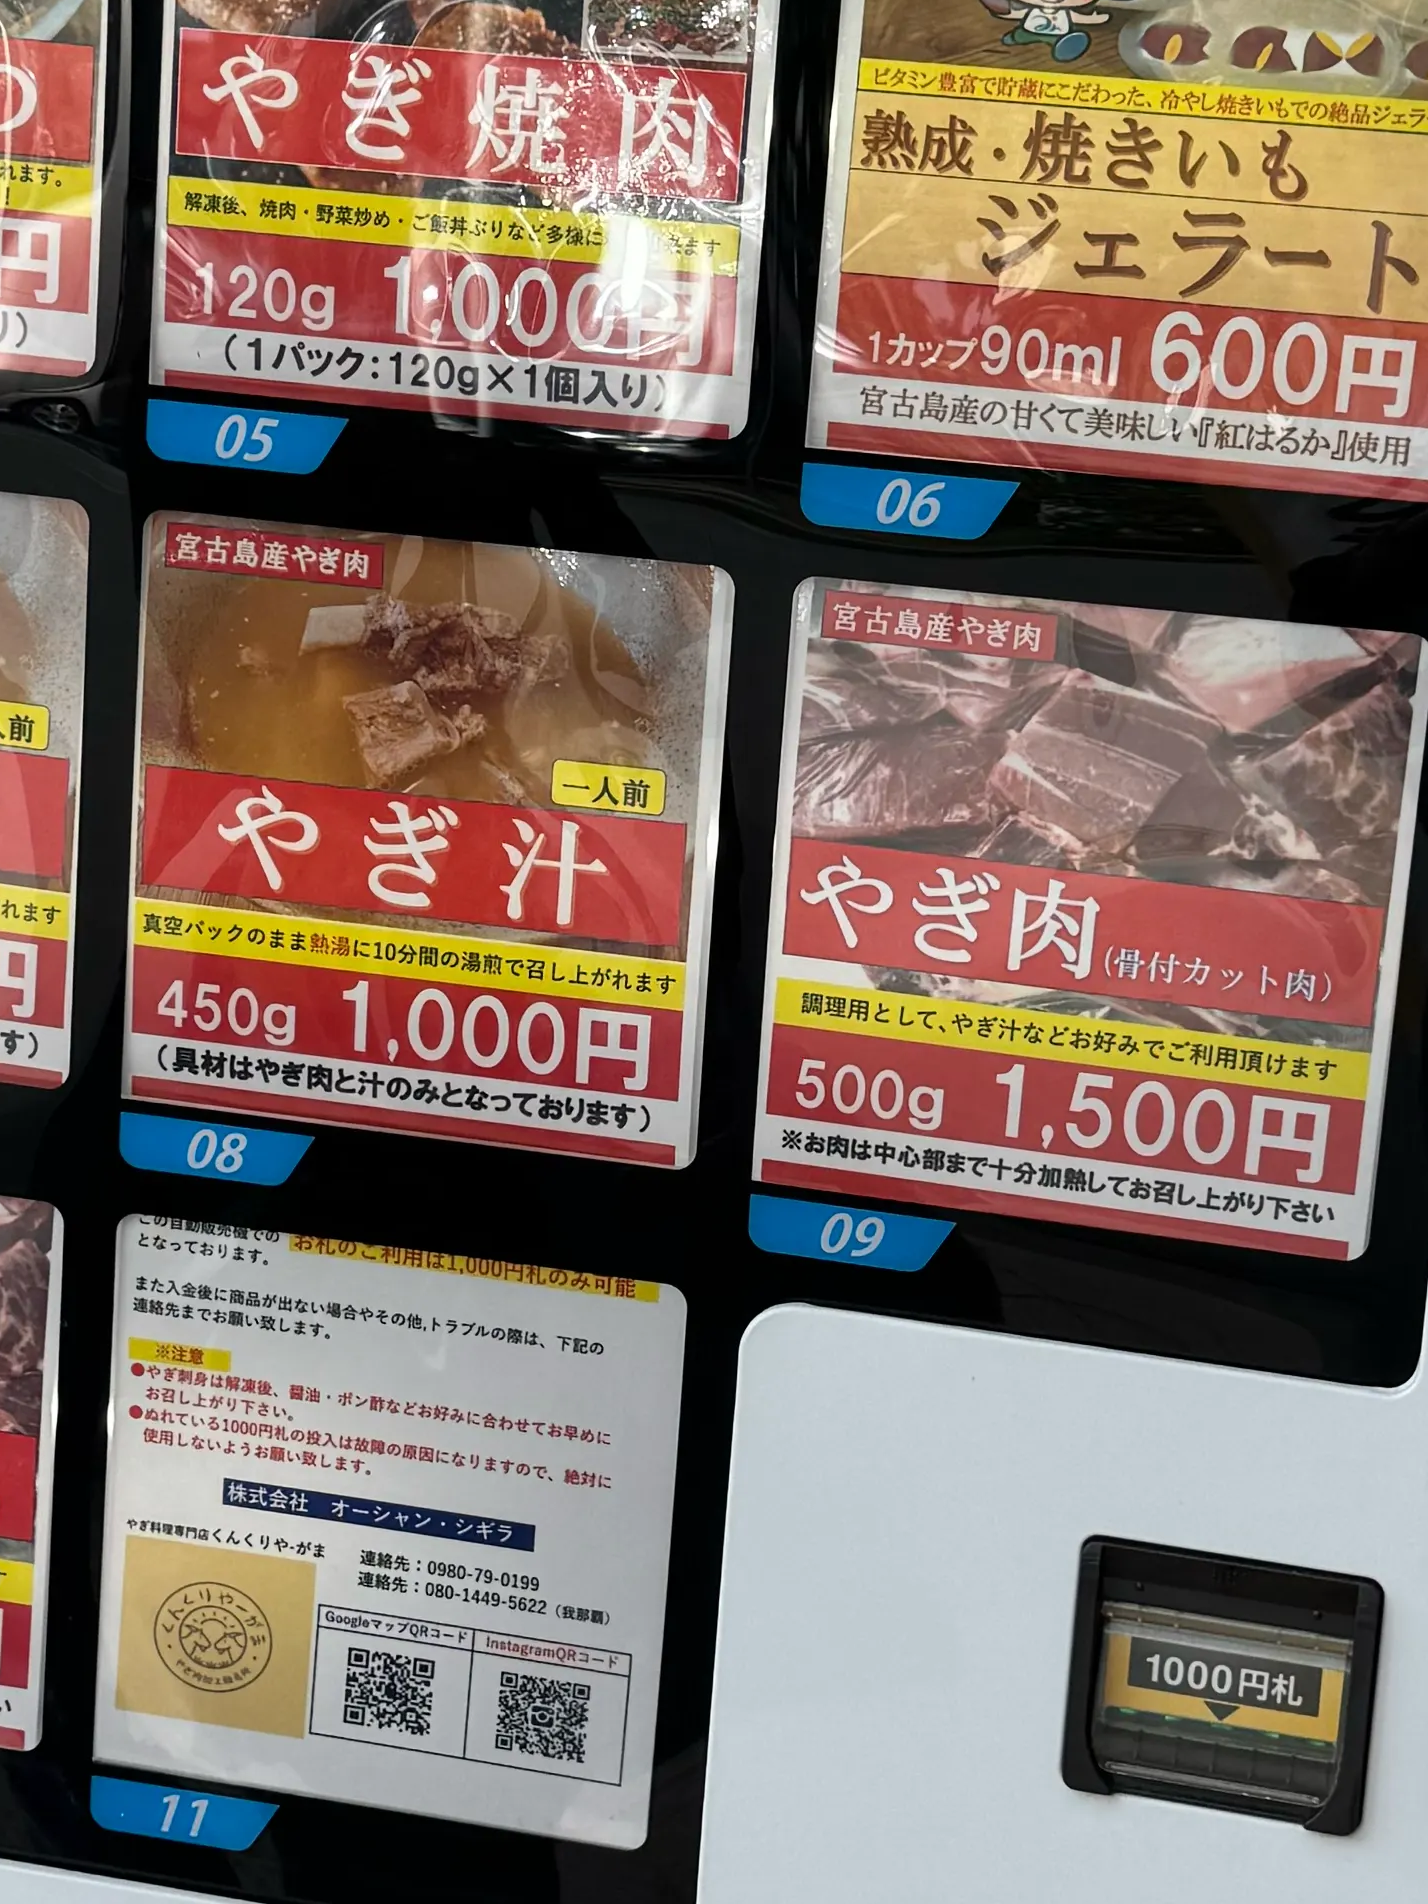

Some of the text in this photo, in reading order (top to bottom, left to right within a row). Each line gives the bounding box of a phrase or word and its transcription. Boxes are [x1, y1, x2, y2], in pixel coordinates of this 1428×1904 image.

[203, 44, 714, 189] やぎ焼肉
[860, 107, 1310, 202] 熟成・焼きいも
[976, 192, 1420, 315] ジェラート
[194, 254, 713, 368] 120g 1,000円
[869, 310, 1418, 420] 1カップ90ml 600円
[215, 413, 280, 463] 05
[860, 385, 1412, 468] 宮古島産の甘くて美味しい『紅はるか』使用
[876, 477, 945, 528] 06
[174, 530, 370, 580] 宮古島産やぎ肉
[831, 600, 1043, 653] 宮古島産やぎ肉
[561, 777, 651, 810] 一人前
[217, 784, 608, 927] やぎ汁
[157, 979, 653, 1094] 450g 1,000円
[800, 991, 1339, 1082] 調理用として、やぎ汁などお好みでご利用頂けます
[156, 1042, 652, 1134] （具材はやぎ肉と汁のみとなっております）
[794, 1058, 1333, 1186] 500g 1,500円
[185, 1127, 248, 1174] 08
[780, 1129, 1336, 1226] ※お肉は中心部まで十分加熱してお召し上がり下さい
[137, 1232, 271, 1267] となっております。
[819, 1211, 886, 1258] 09
[132, 1297, 333, 1341] 連絡先までお願い致します。
[155, 1343, 206, 1366] ※注意
[145, 1385, 297, 1422] お召し上がり下さい。
[142, 1427, 375, 1477] 使用しないようお願い致します。
[227, 1481, 514, 1544] 株式会社 オーシャン・シギラ
[325, 1607, 468, 1647] GoogleマップQRコード
[485, 1634, 619, 1672] InstagramQRコード
[1144, 1652, 1305, 1706] 1000円札
[160, 1793, 210, 1839] 11
